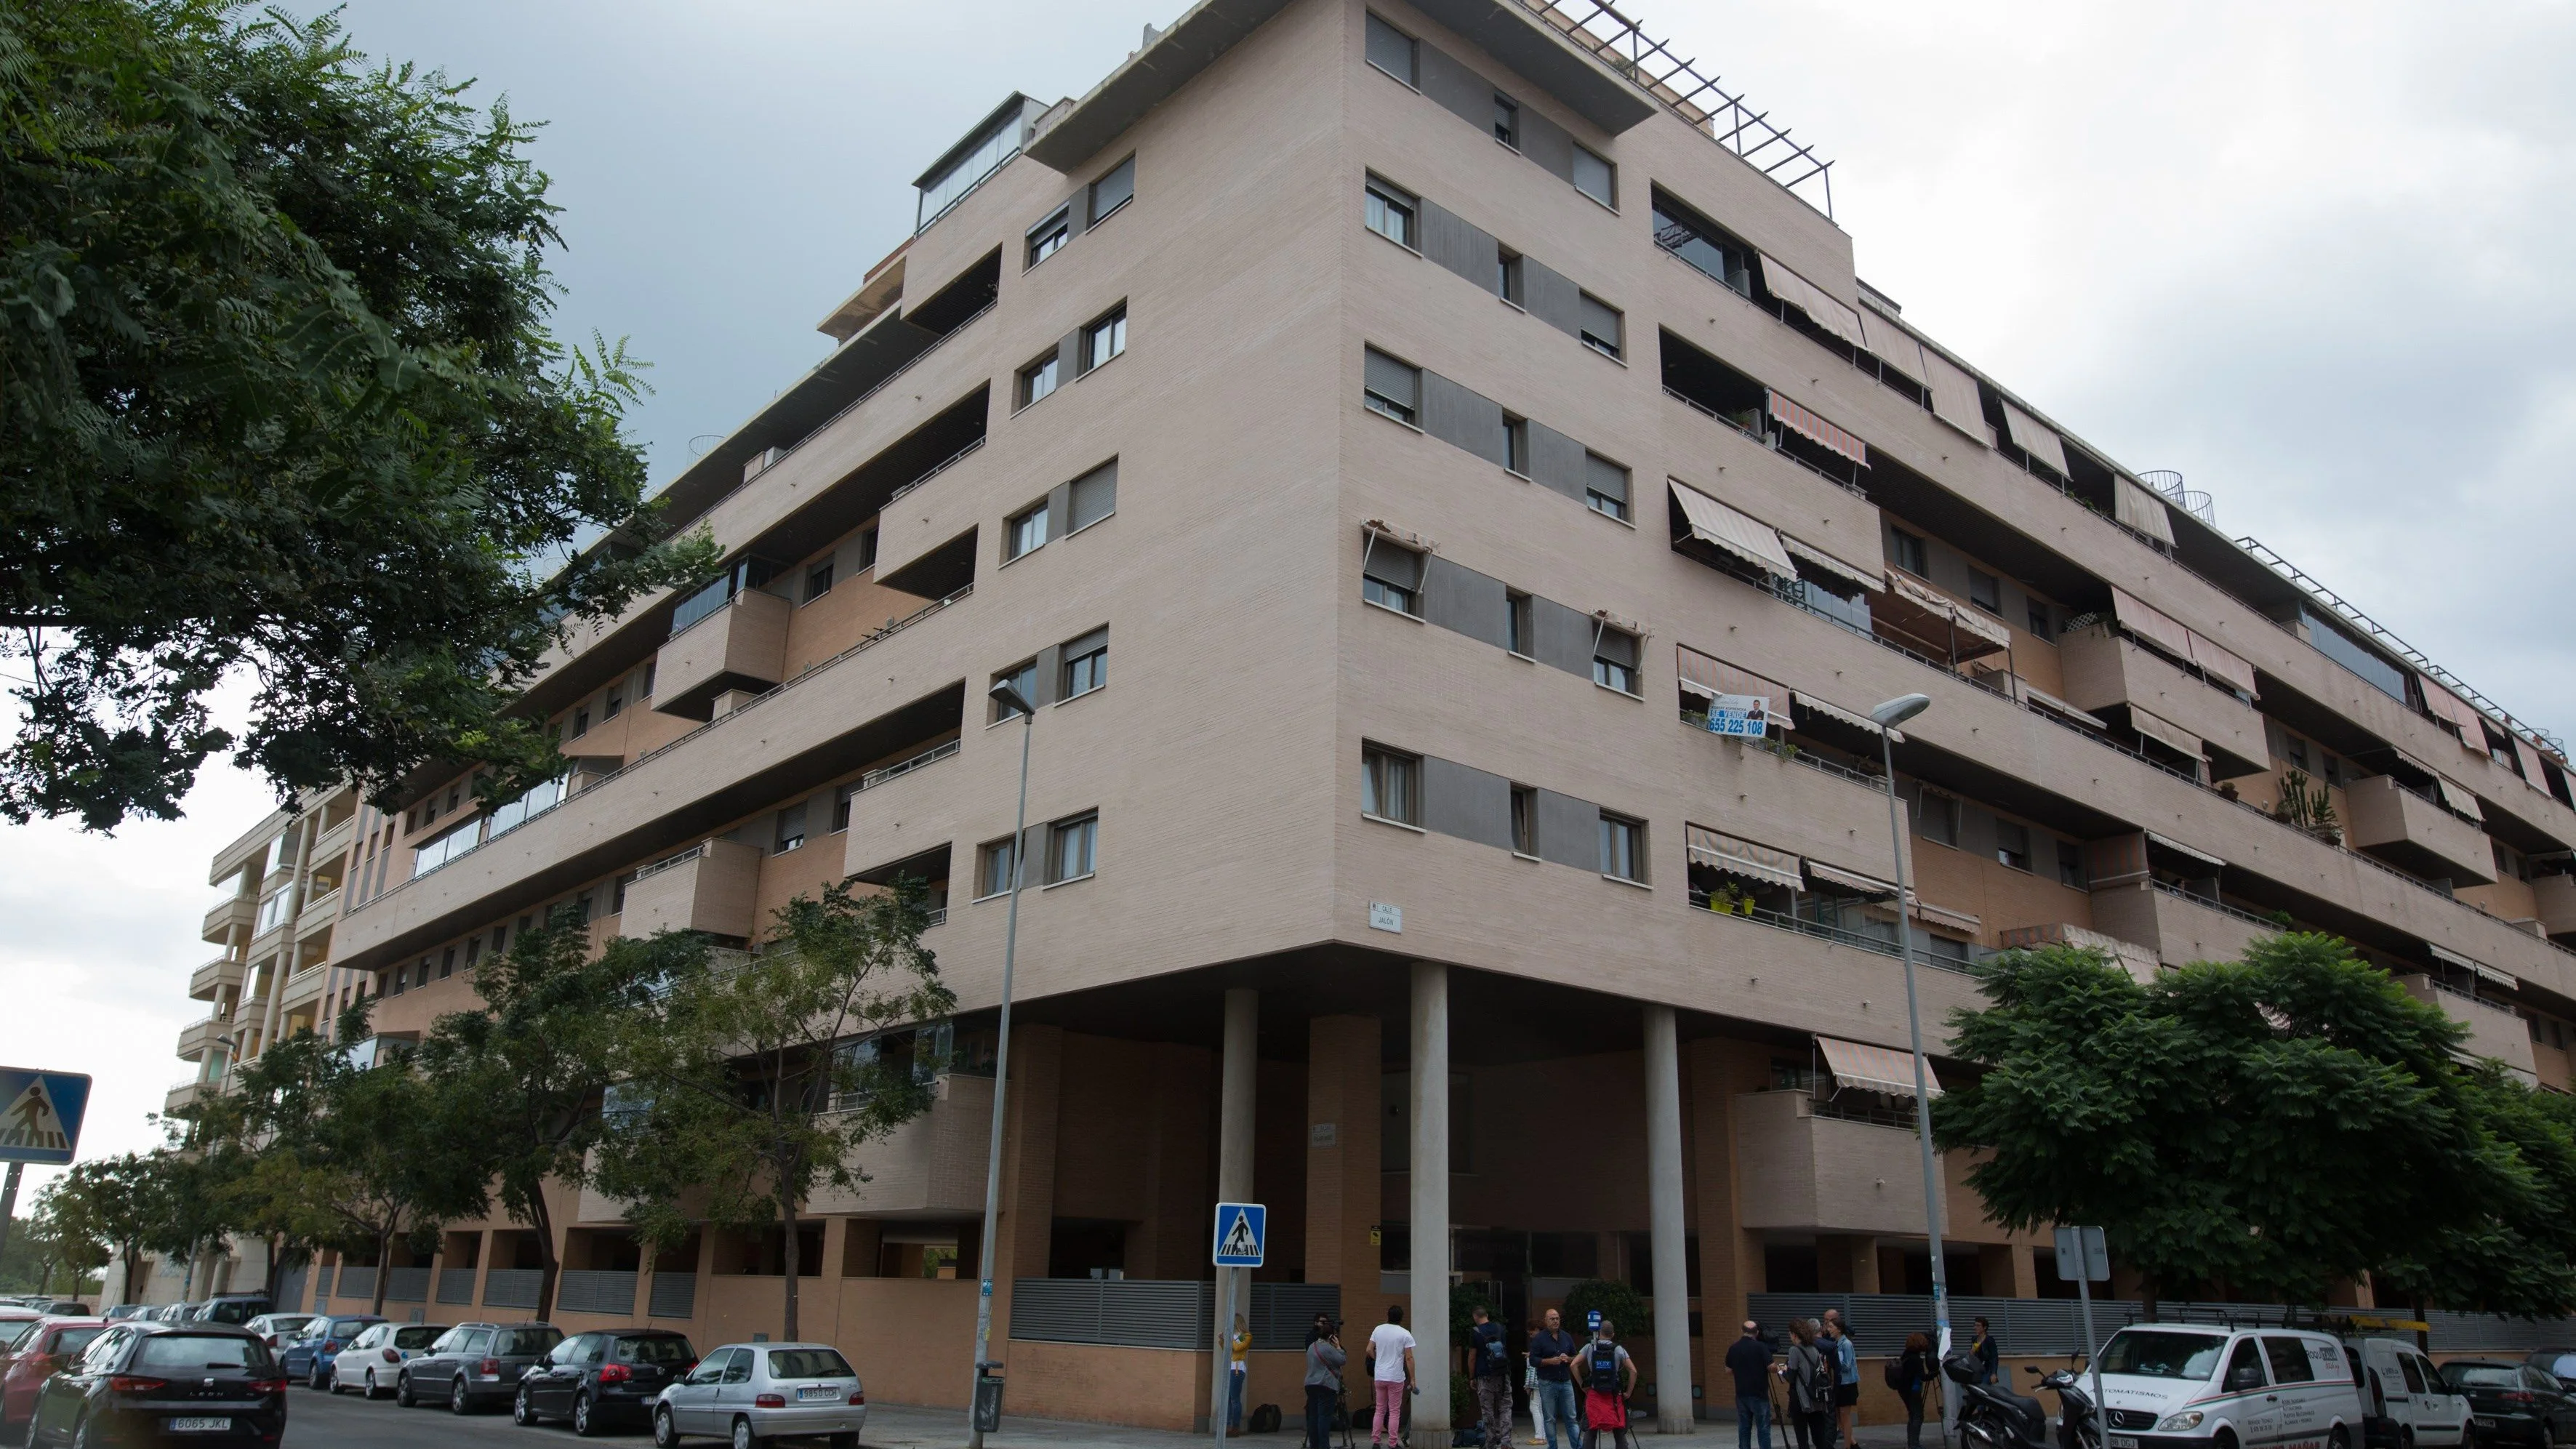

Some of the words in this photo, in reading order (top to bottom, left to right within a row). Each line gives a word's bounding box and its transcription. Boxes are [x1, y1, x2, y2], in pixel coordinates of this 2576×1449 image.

[1724, 710, 1746, 719] VENDE
[1709, 718, 1725, 731] 655
[1728, 719, 1744, 734] 225
[1747, 721, 1763, 735] 108
[1378, 917, 1394, 926] JALÓN
[2088, 1389, 2168, 1399] ATOMATISMOS
[177, 1418, 206, 1429] 6065
[208, 1418, 228, 1429] JKL
